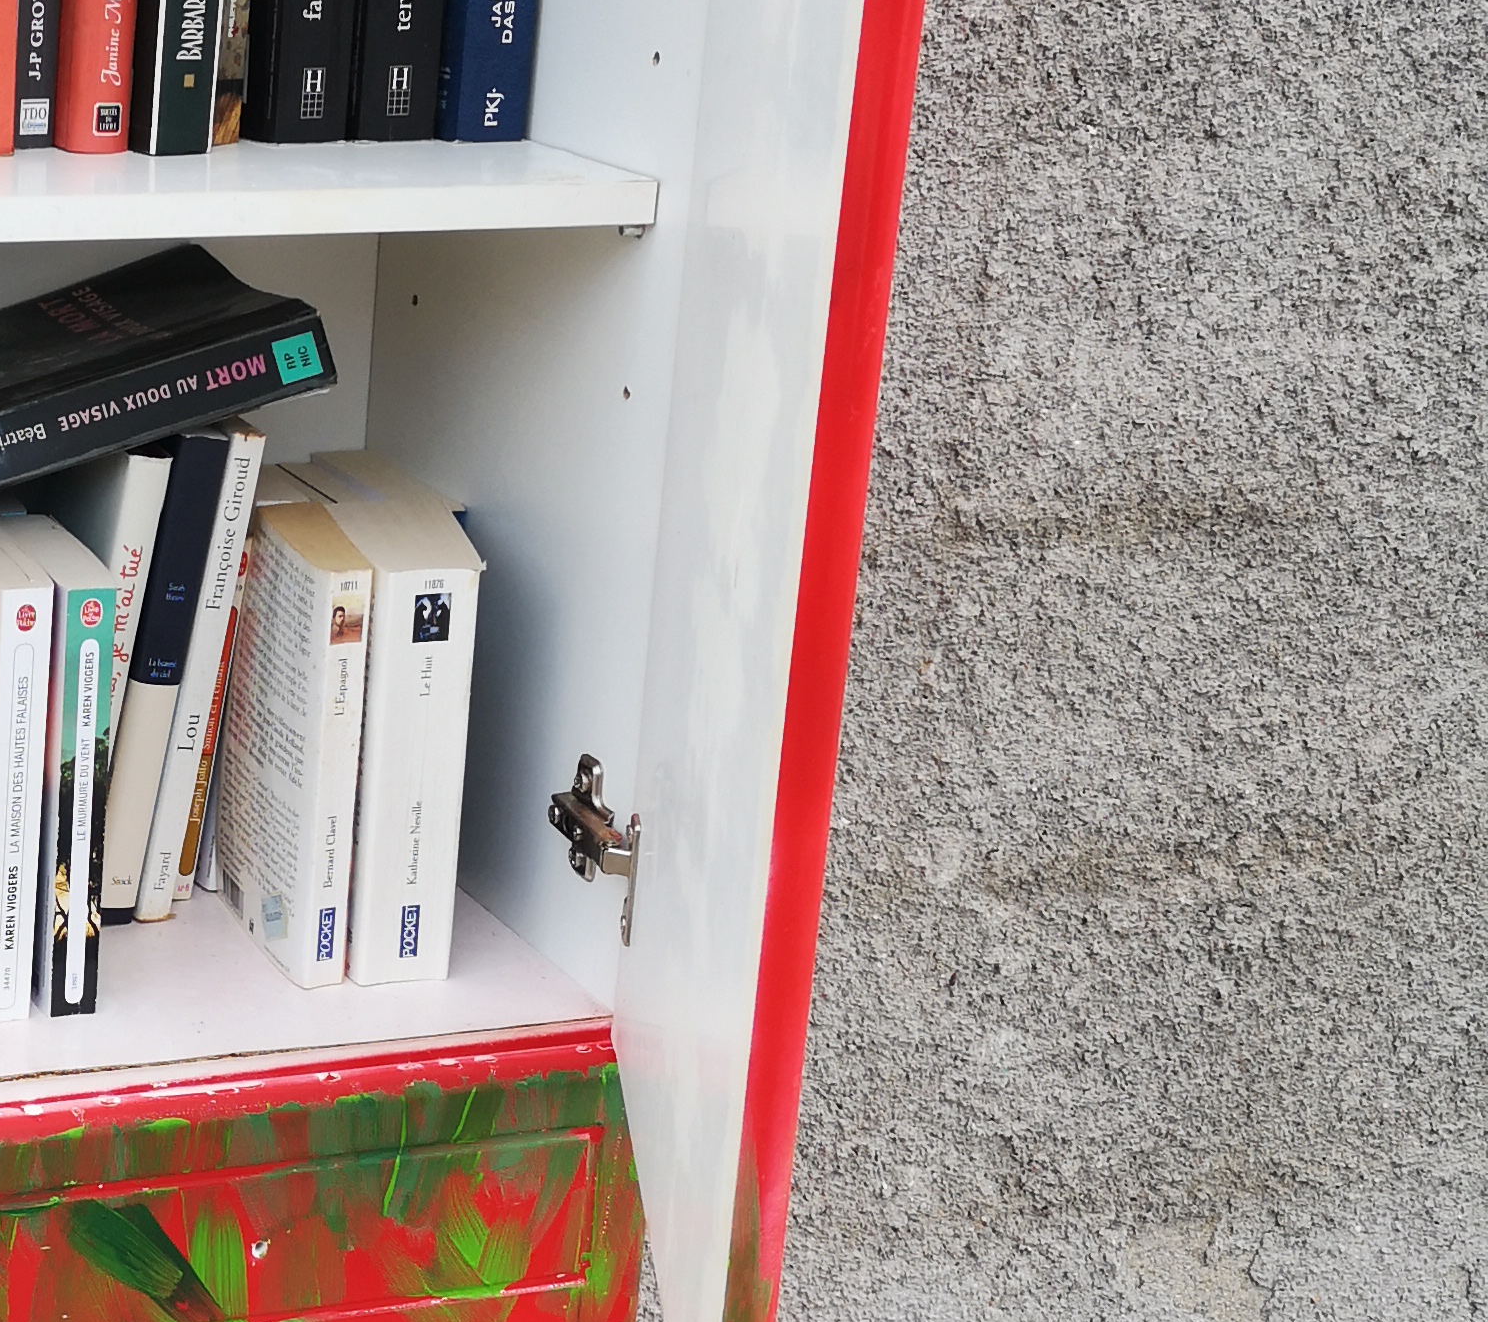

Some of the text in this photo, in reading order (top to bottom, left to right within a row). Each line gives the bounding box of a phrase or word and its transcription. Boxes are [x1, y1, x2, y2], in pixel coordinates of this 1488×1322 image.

[205, 353, 267, 391] MORT
[297, 345, 311, 367] NIC
[122, 383, 172, 413] DOUX
[176, 374, 199, 396] AU
[57, 399, 122, 433] VISAGE
[176, 456, 251, 754] Lou Françoise Giroud
[76, 652, 95, 842] LE MURMURE DU VENT KAREN VIGGERS
[3, 675, 29, 951] KAREN VIGGERS LA MAISON DES HAUTES FALAISES
[323, 815, 338, 889] Bernard Clavel
[406, 800, 423, 886] Katherine Neville
[318, 908, 336, 962] POCKET
[402, 904, 421, 959] POCKET
